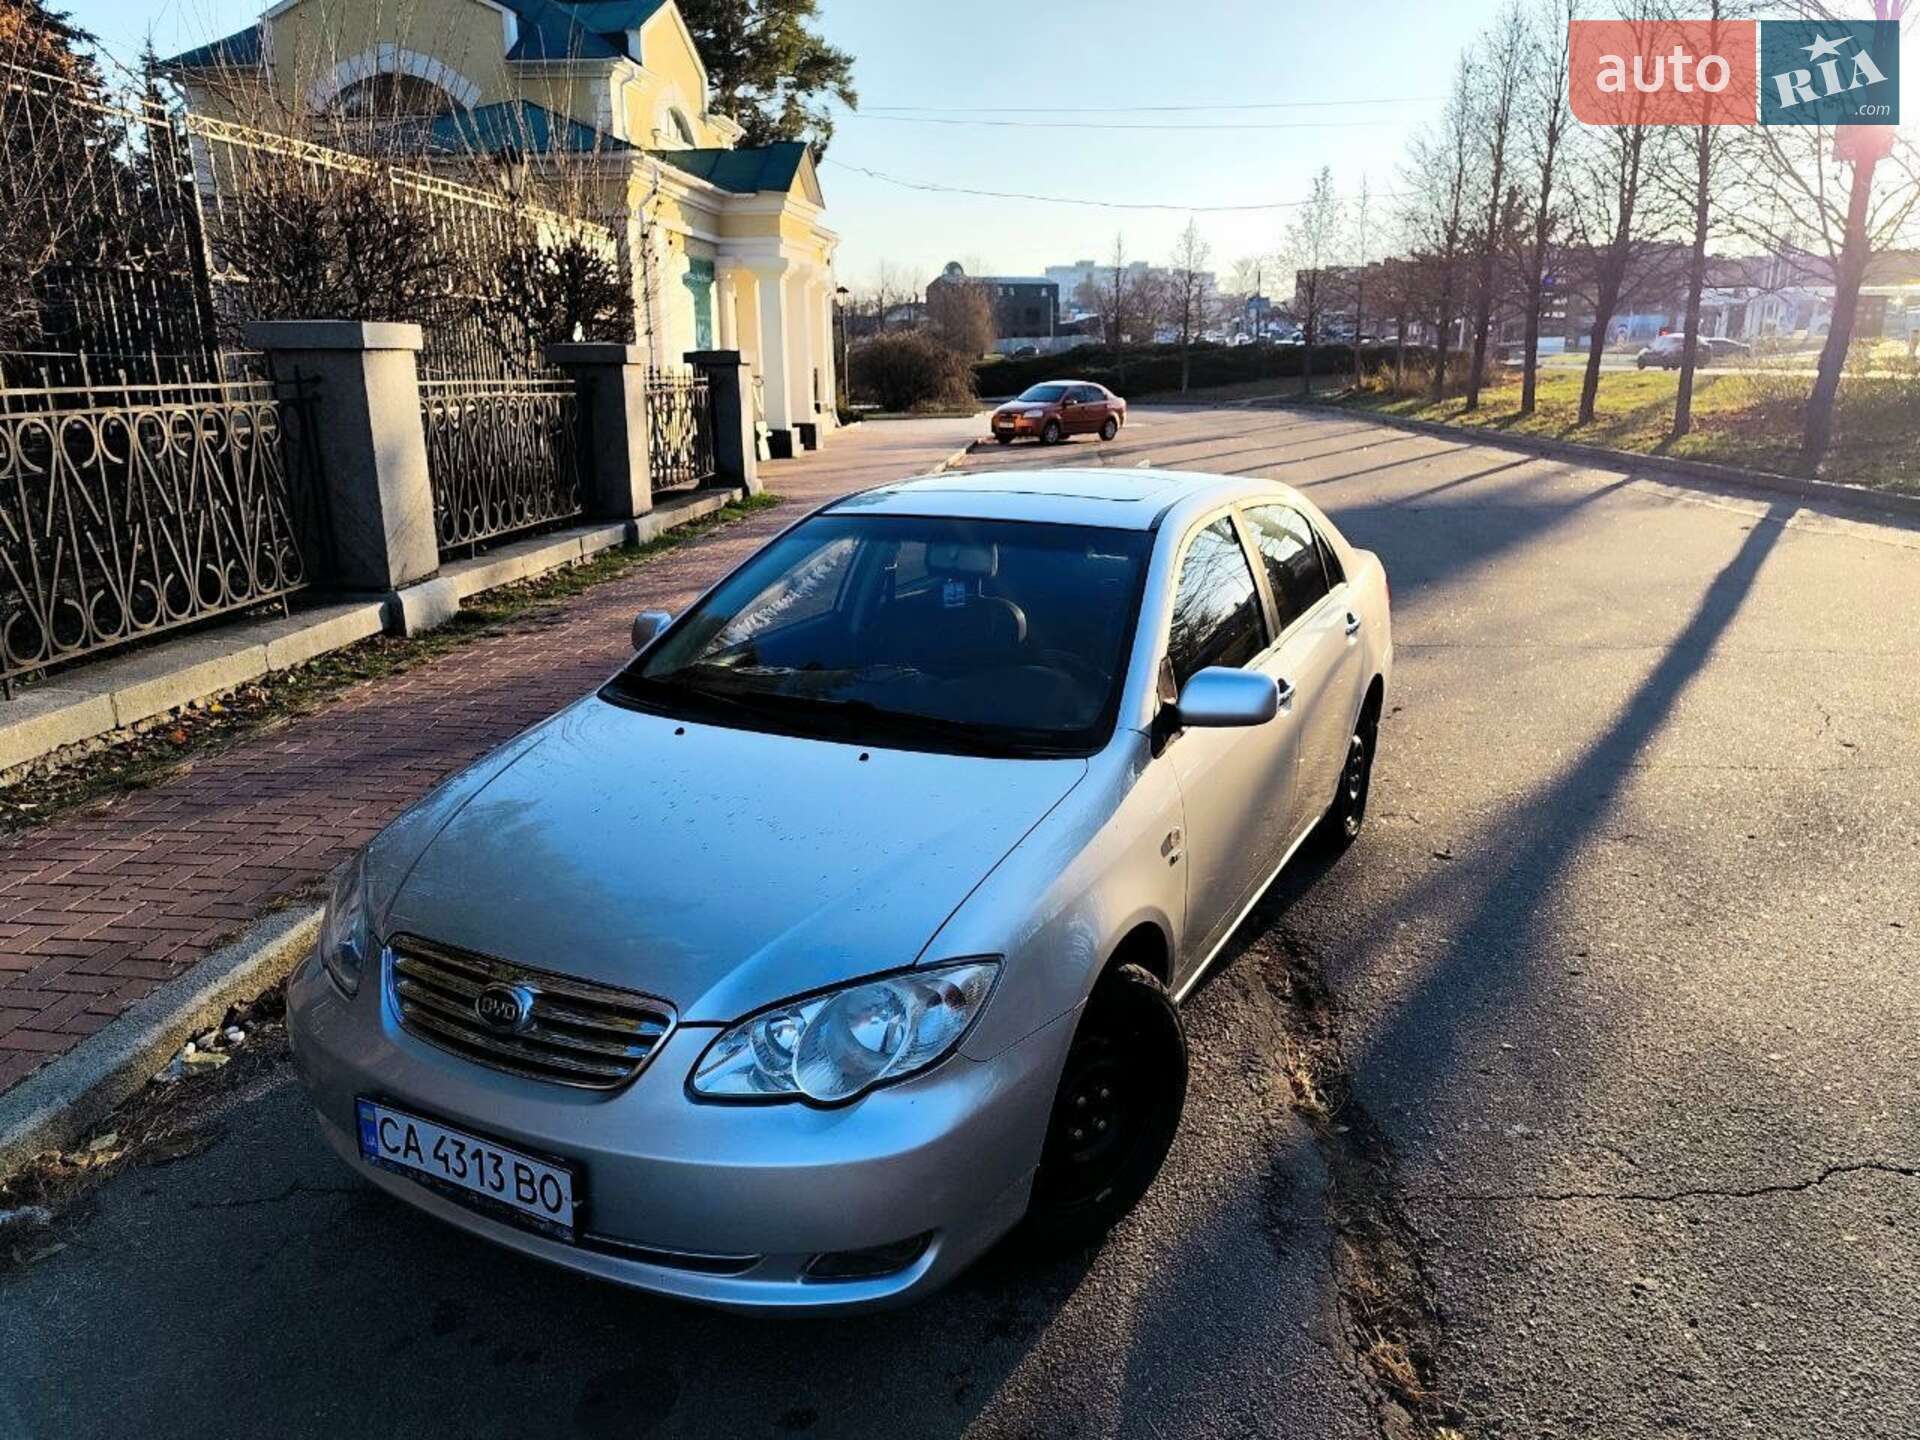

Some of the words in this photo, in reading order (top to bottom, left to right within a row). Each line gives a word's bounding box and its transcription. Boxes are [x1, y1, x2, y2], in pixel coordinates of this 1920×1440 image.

[379, 1117, 424, 1164] CA
[433, 1135, 505, 1193] 4313
[514, 1161, 563, 1214] BO
